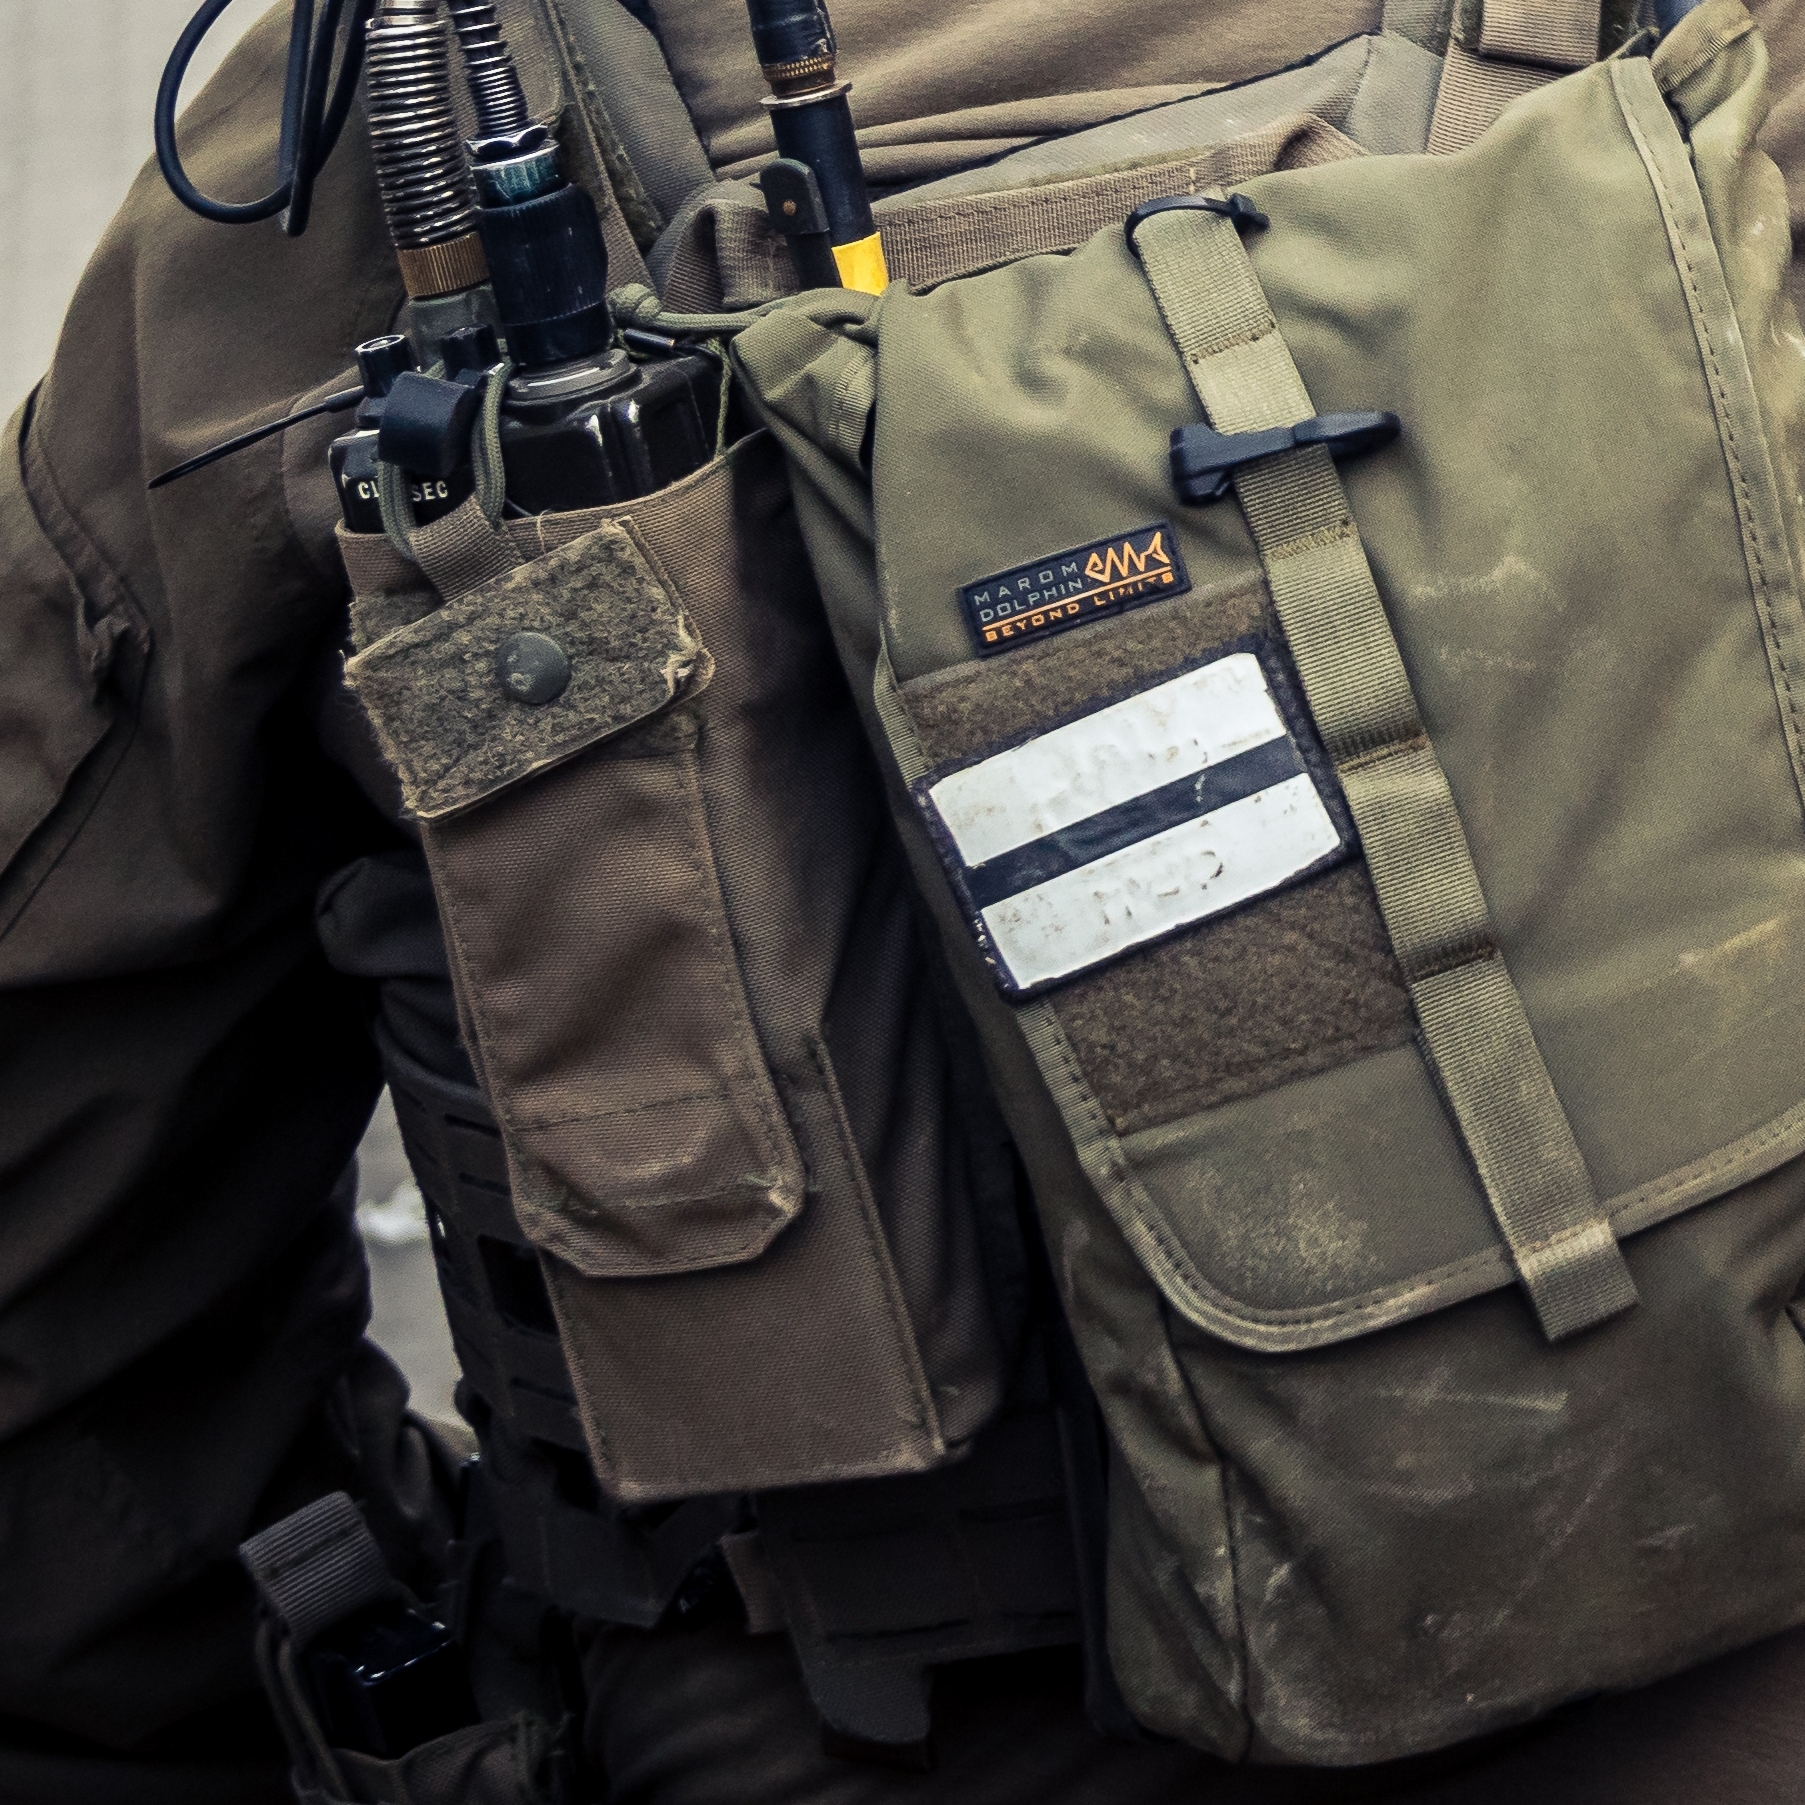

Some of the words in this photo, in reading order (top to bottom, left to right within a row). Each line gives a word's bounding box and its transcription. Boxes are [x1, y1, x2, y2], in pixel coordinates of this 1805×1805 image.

[411, 480, 448, 502] SEC
[974, 562, 1078, 605] MAROM
[979, 578, 1083, 622] DOLPHIN
[985, 602, 1080, 642] BEYOND
